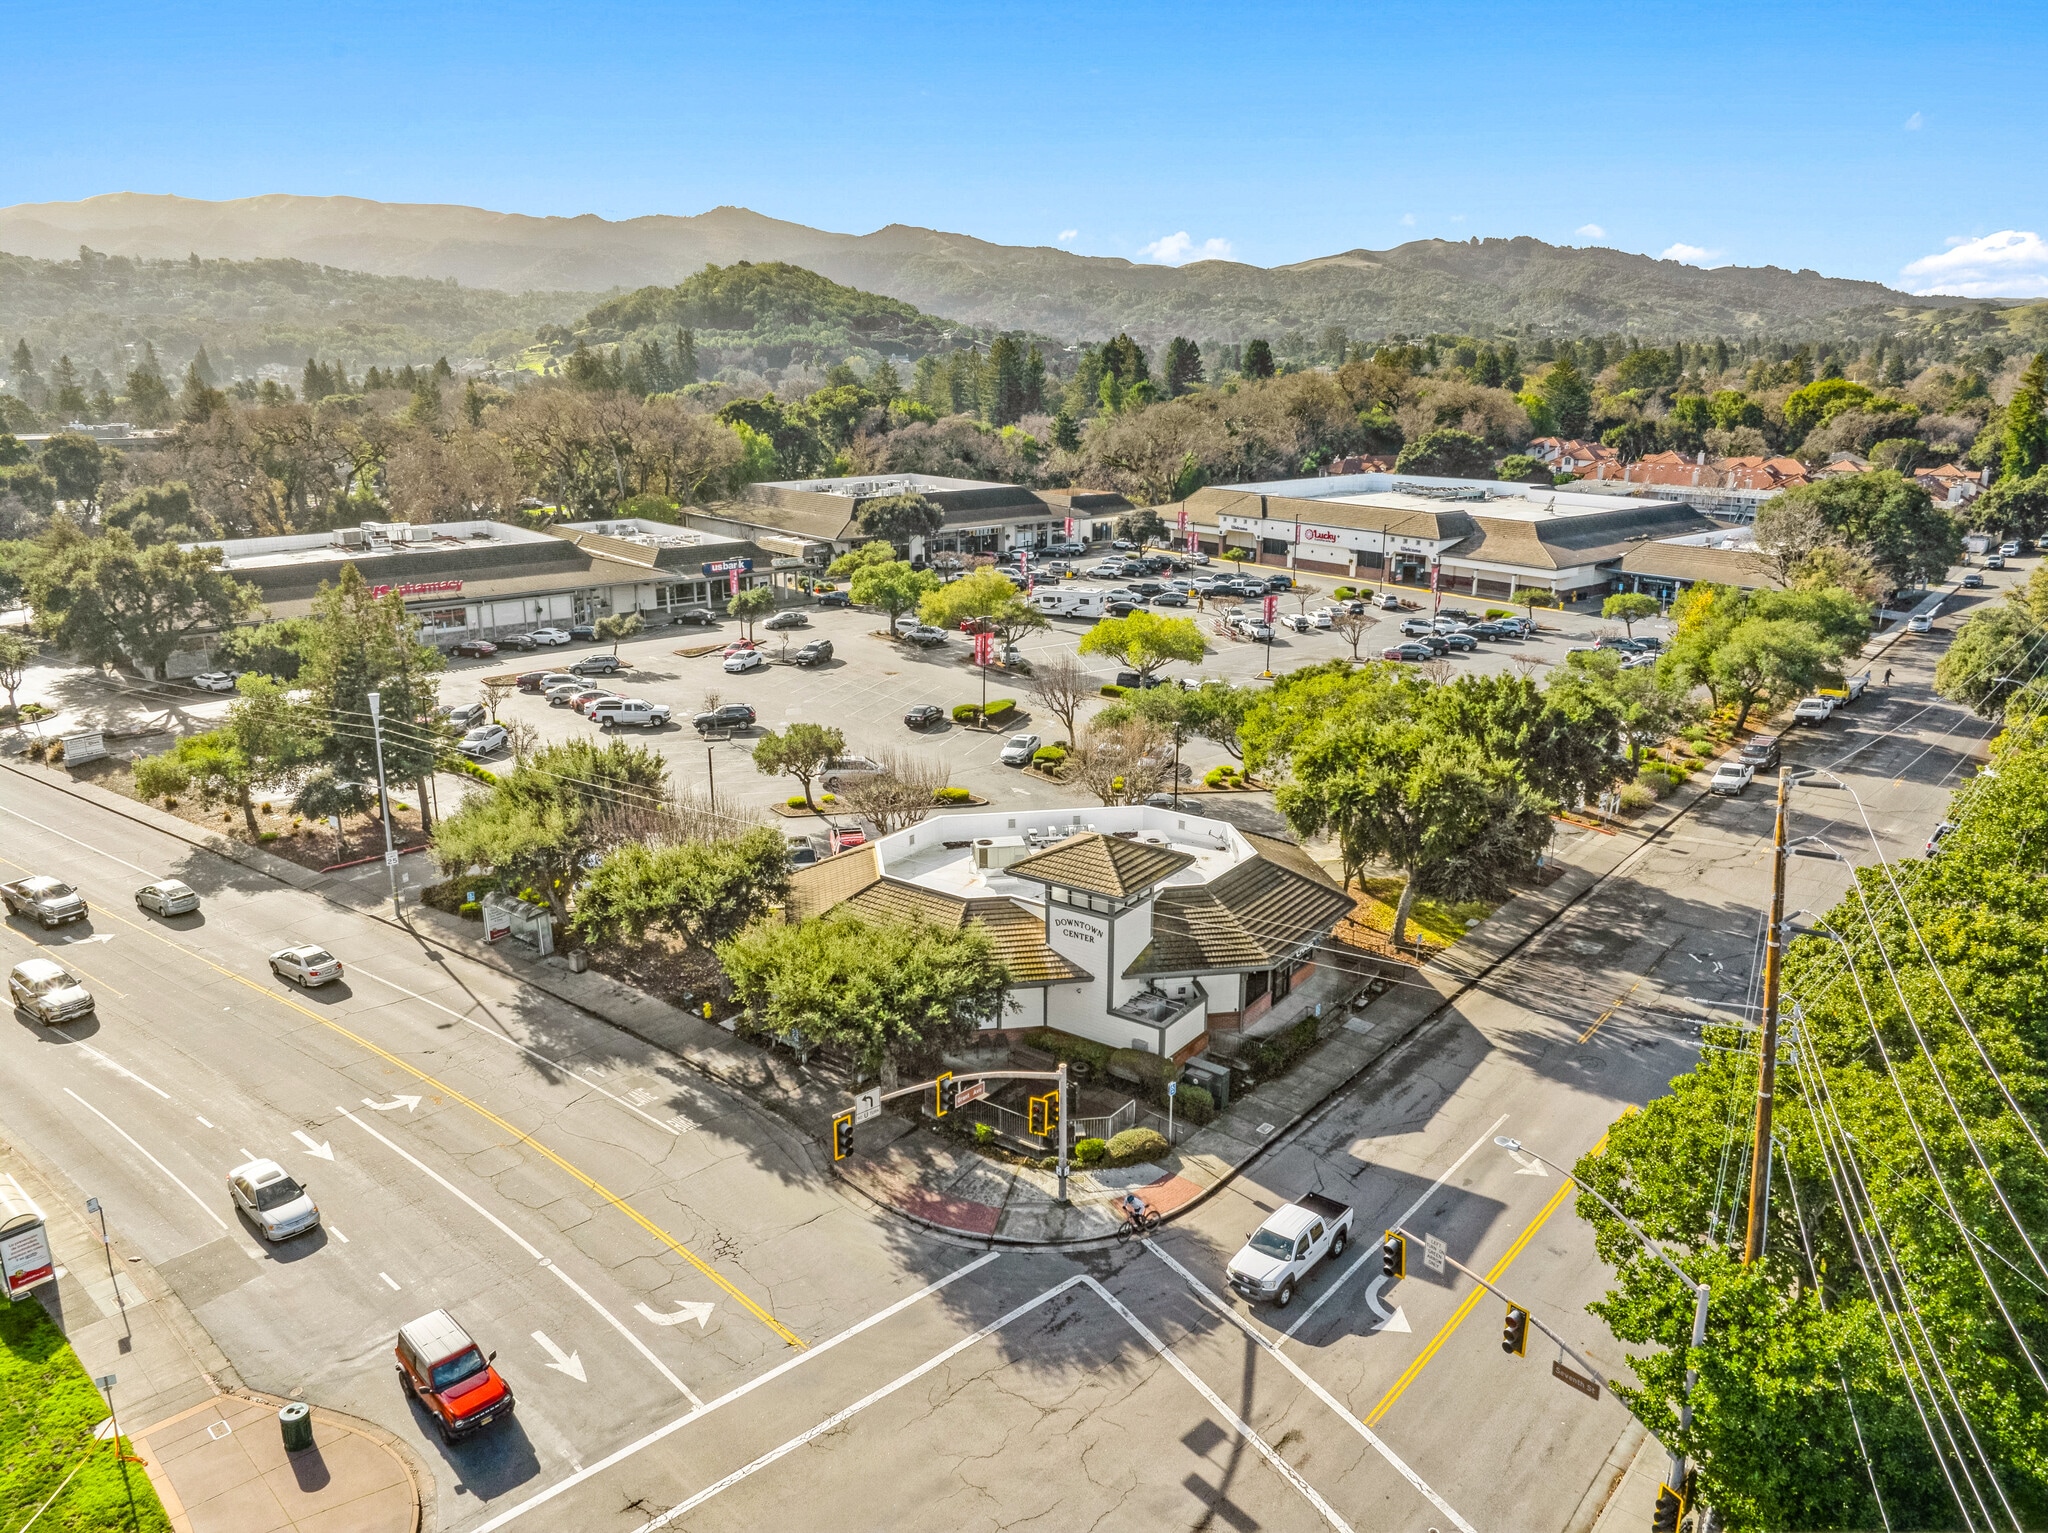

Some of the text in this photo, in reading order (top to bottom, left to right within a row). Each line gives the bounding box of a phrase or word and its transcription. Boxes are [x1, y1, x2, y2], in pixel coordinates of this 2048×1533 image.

[1313, 530, 1336, 543] Lucky
[387, 857, 398, 865] 25
[1055, 918, 1104, 938] DOWNTOWN
[1062, 928, 1095, 943] CENTER
[957, 1092, 970, 1103] Grant
[1555, 1366, 1595, 1394] Seventh St
